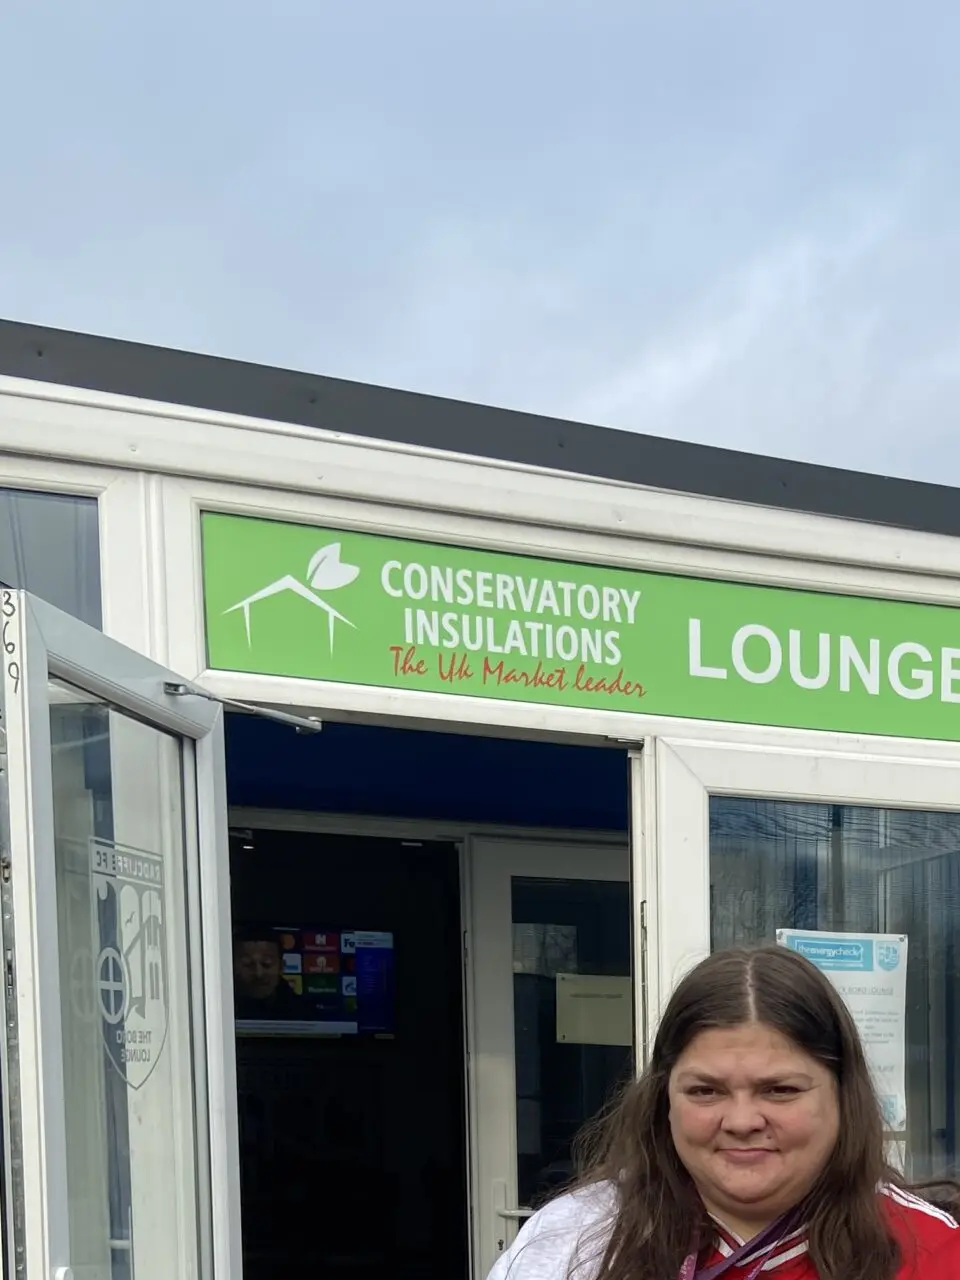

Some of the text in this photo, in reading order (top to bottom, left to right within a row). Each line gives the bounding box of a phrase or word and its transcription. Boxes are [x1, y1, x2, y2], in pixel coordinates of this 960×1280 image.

[381, 560, 641, 624] CONSERVATORY
[404, 607, 622, 666] INSULATIONS
[389, 645, 647, 699] The Uk Market leader
